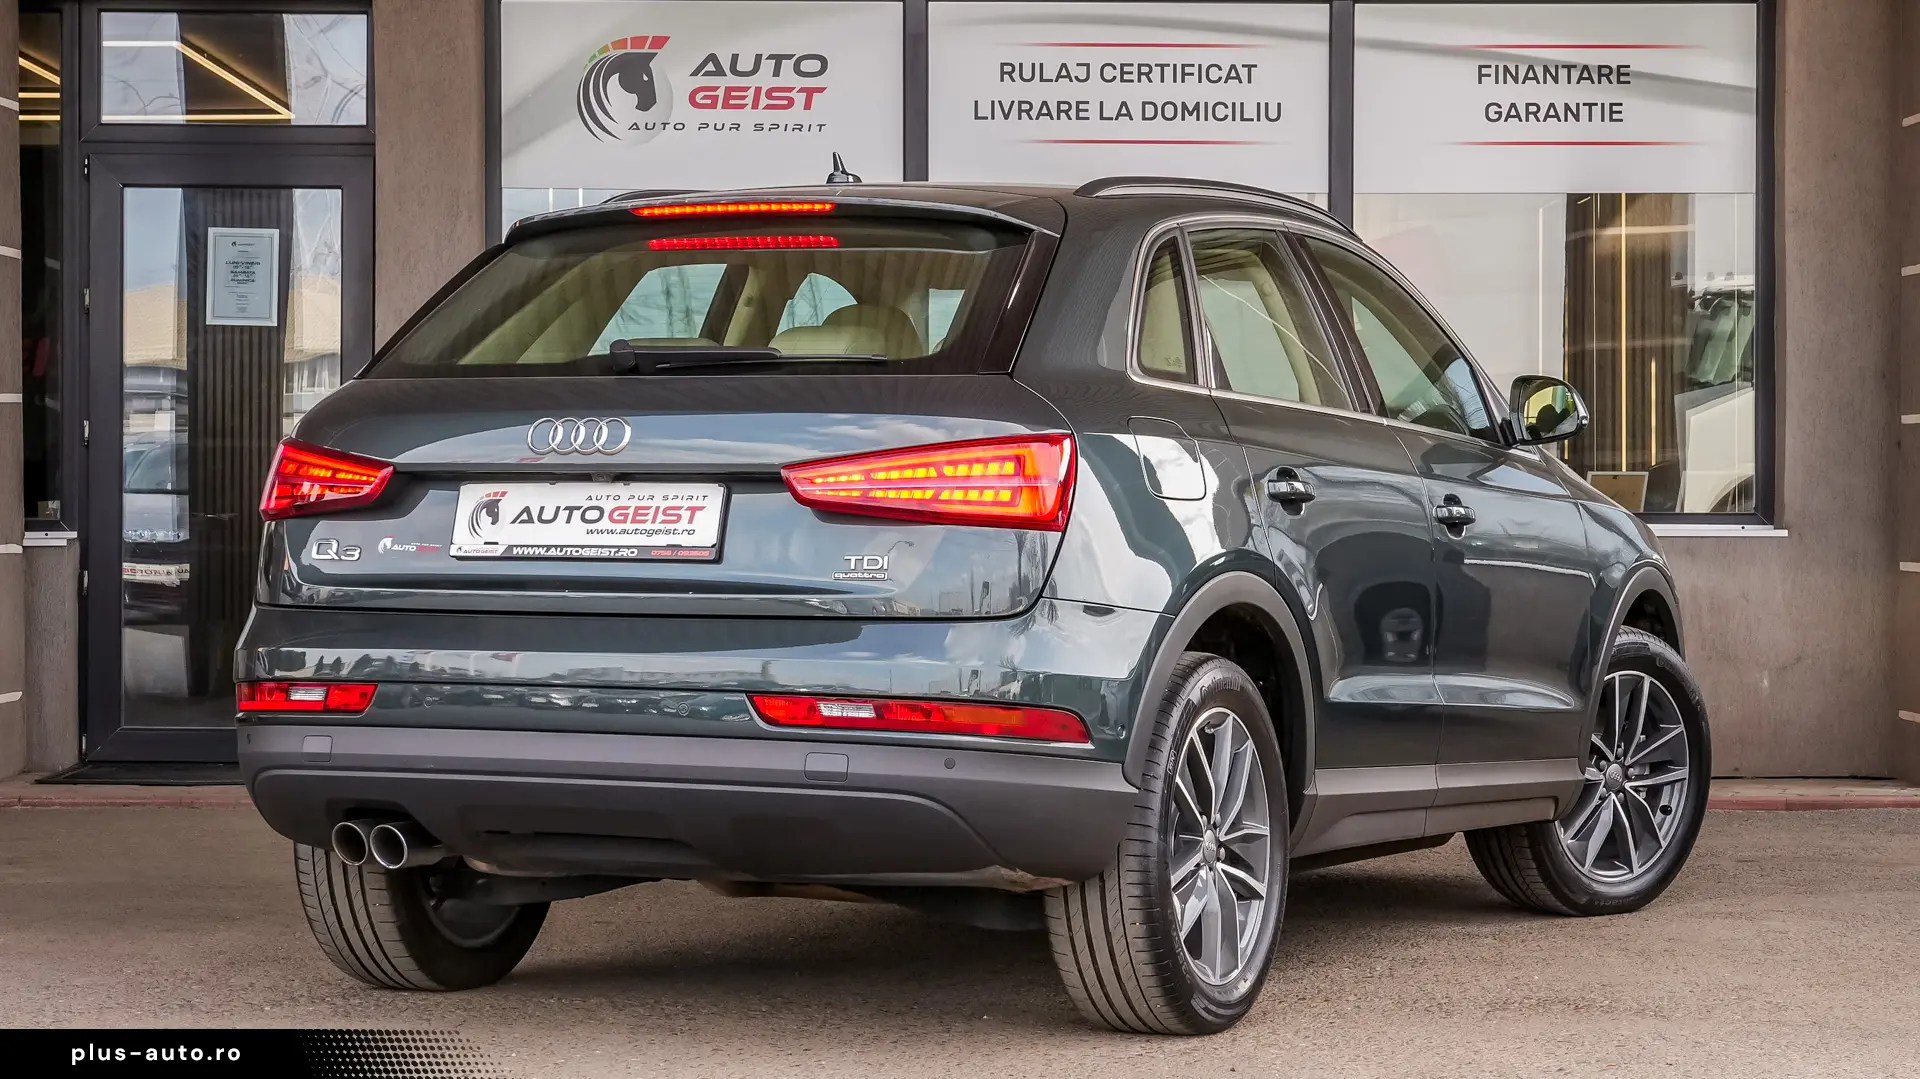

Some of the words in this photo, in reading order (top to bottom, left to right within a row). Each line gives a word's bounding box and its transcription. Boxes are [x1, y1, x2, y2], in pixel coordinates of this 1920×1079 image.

[689, 52, 829, 78] AUTO
[999, 62, 1091, 83] RULAJ
[1099, 62, 1258, 84] CERTIFICAT
[1477, 64, 1632, 85] FINANTARE
[688, 86, 828, 110] GEIST
[973, 99, 1091, 121] LIVRARE
[1099, 100, 1134, 121] LA
[1141, 100, 1283, 123] DOMICILIU
[1483, 102, 1625, 123] GARANTIE
[627, 121, 686, 132] AUTO
[697, 122, 742, 132] PUR
[752, 123, 828, 133] SPIRIT
[510, 505, 707, 524] AUTOGEIST
[586, 527, 696, 537] www.autogeist.ro
[311, 538, 361, 561] Q3
[512, 546, 638, 557] WWW.AUTOGEIST.RO
[843, 555, 890, 571] TDI
